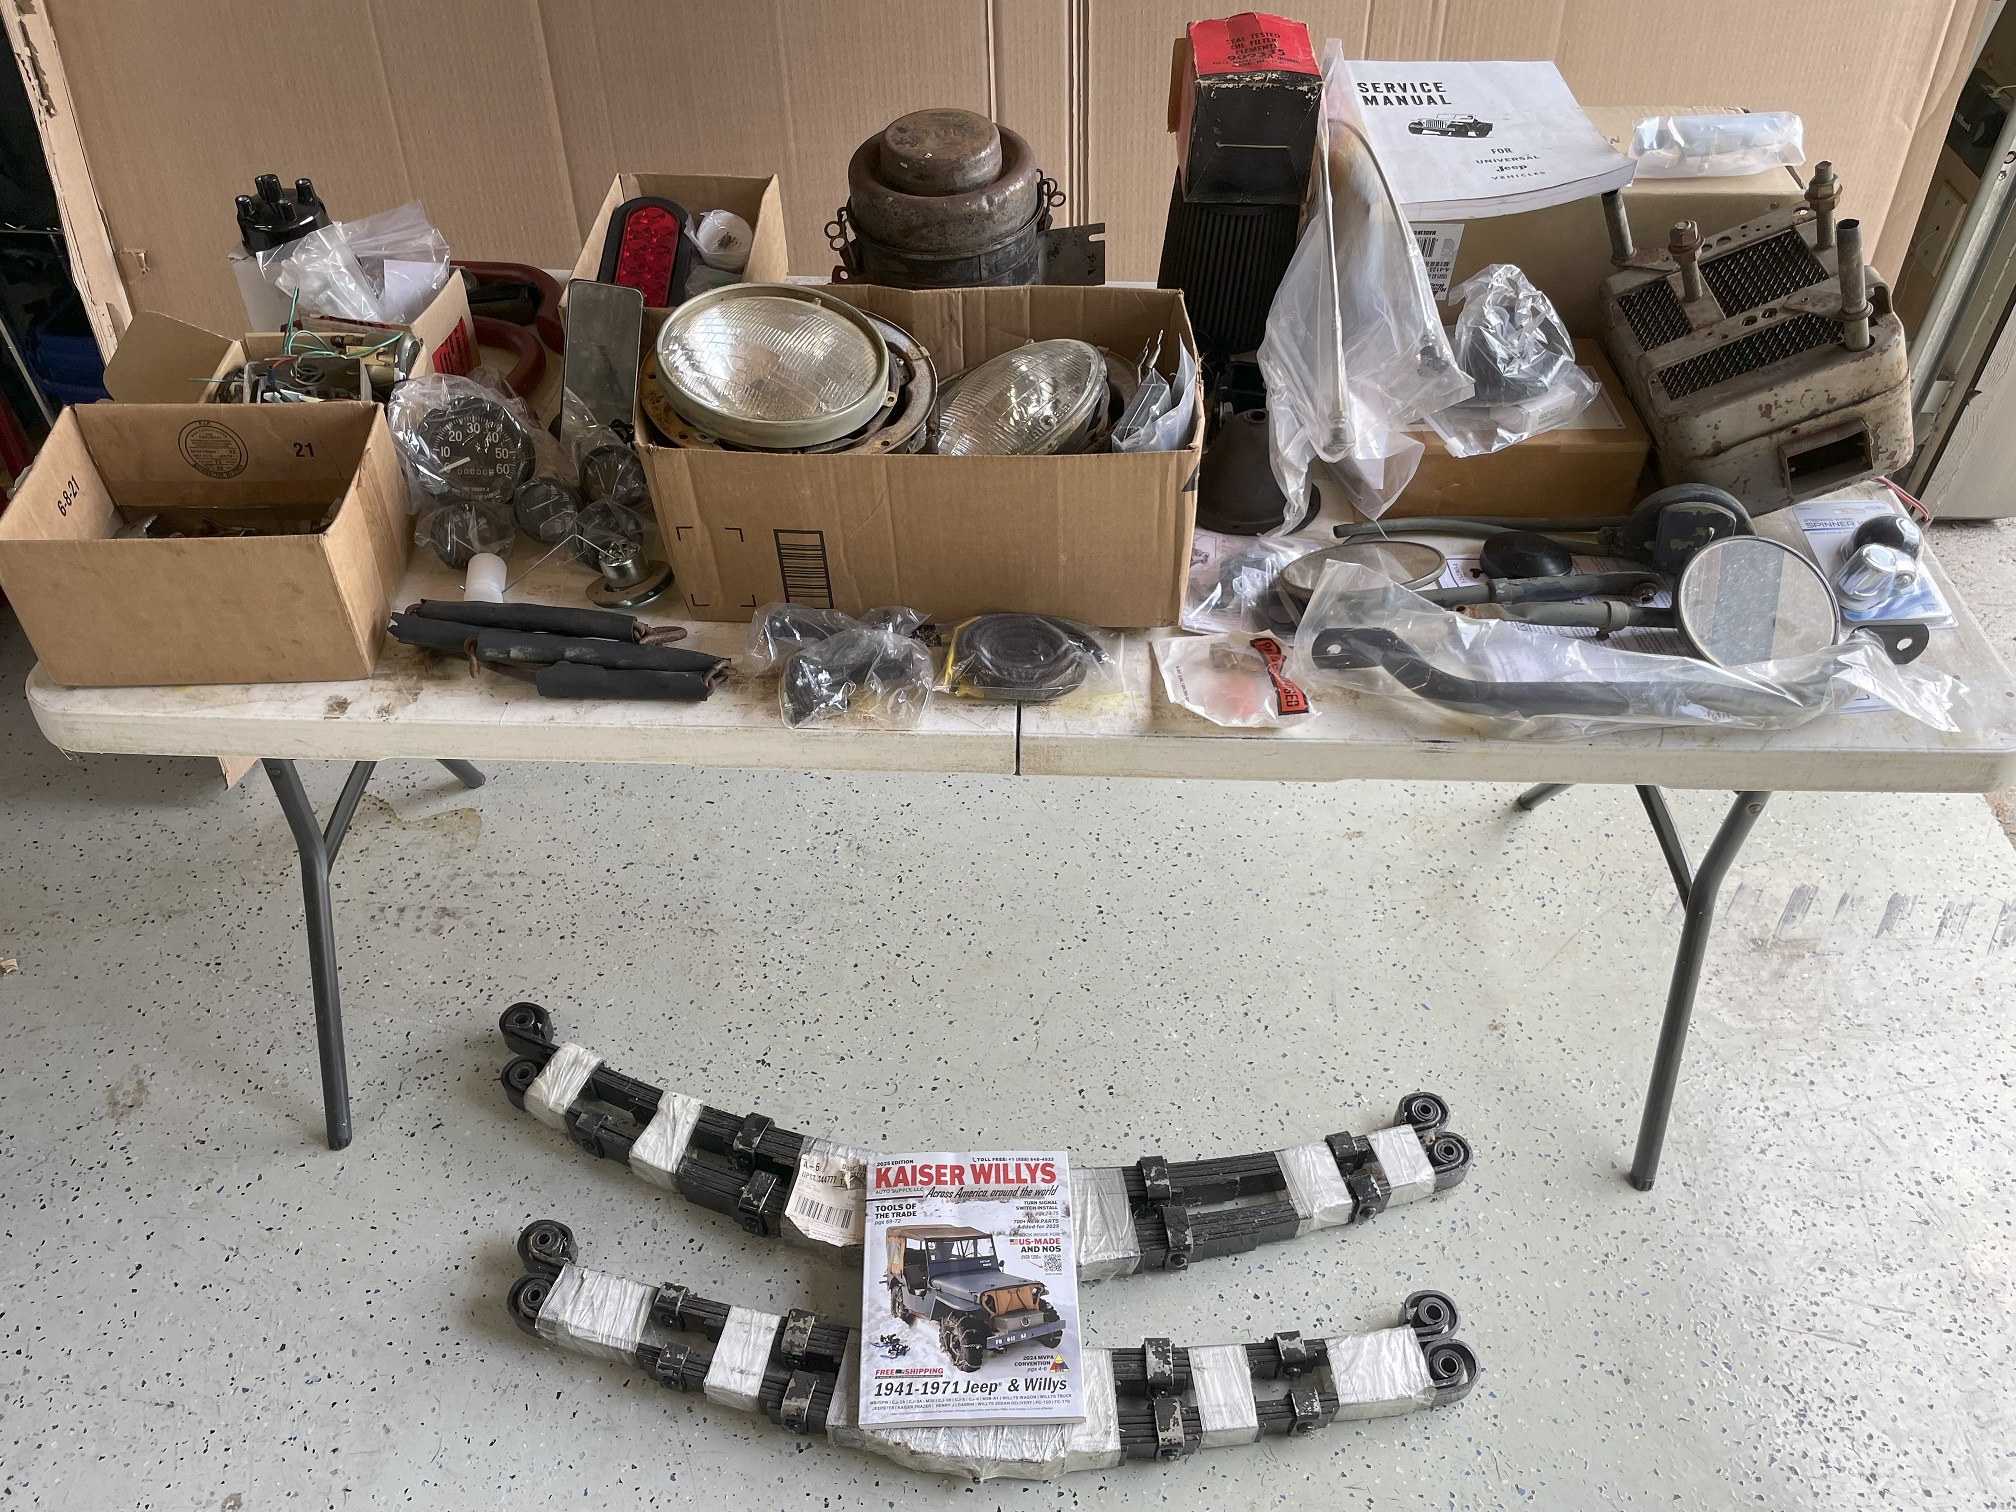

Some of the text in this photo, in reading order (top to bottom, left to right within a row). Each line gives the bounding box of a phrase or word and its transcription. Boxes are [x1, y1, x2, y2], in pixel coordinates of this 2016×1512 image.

[1231, 38, 1277, 50] OIL FILTER
[1357, 82, 1447, 93] SERVICE
[1361, 94, 1452, 106] MANUAL
[1475, 155, 1541, 164] UNIVERSAL
[1496, 164, 1527, 172] Jeep
[1491, 171, 1546, 180] VEHICLES
[466, 422, 480, 434] 30
[448, 430, 463, 442] 20
[487, 431, 499, 443] 40
[293, 442, 315, 457] 21
[440, 446, 451, 457] 10
[495, 448, 509, 459] 50
[496, 463, 510, 475] 60
[57, 474, 80, 517] 6-8-21
[1805, 521, 1856, 529] SPINNER
[875, 1164, 966, 1189] KAISER
[969, 1162, 1057, 1185] WILLYS
[925, 1186, 954, 1199] Across
[990, 1185, 1021, 1198] around
[1020, 1185, 1033, 1197] the
[1034, 1185, 1060, 1197] world
[875, 1204, 904, 1212] TOOLS
[1018, 1237, 1061, 1246] US-MADE
[1020, 1245, 1062, 1253] AND NOS
[875, 1367, 944, 1376] FREE SHIPPING
[874, 1379, 960, 1397] 1941-1971
[1007, 1378, 1020, 1392] &
[1024, 1376, 1068, 1394] Willys
